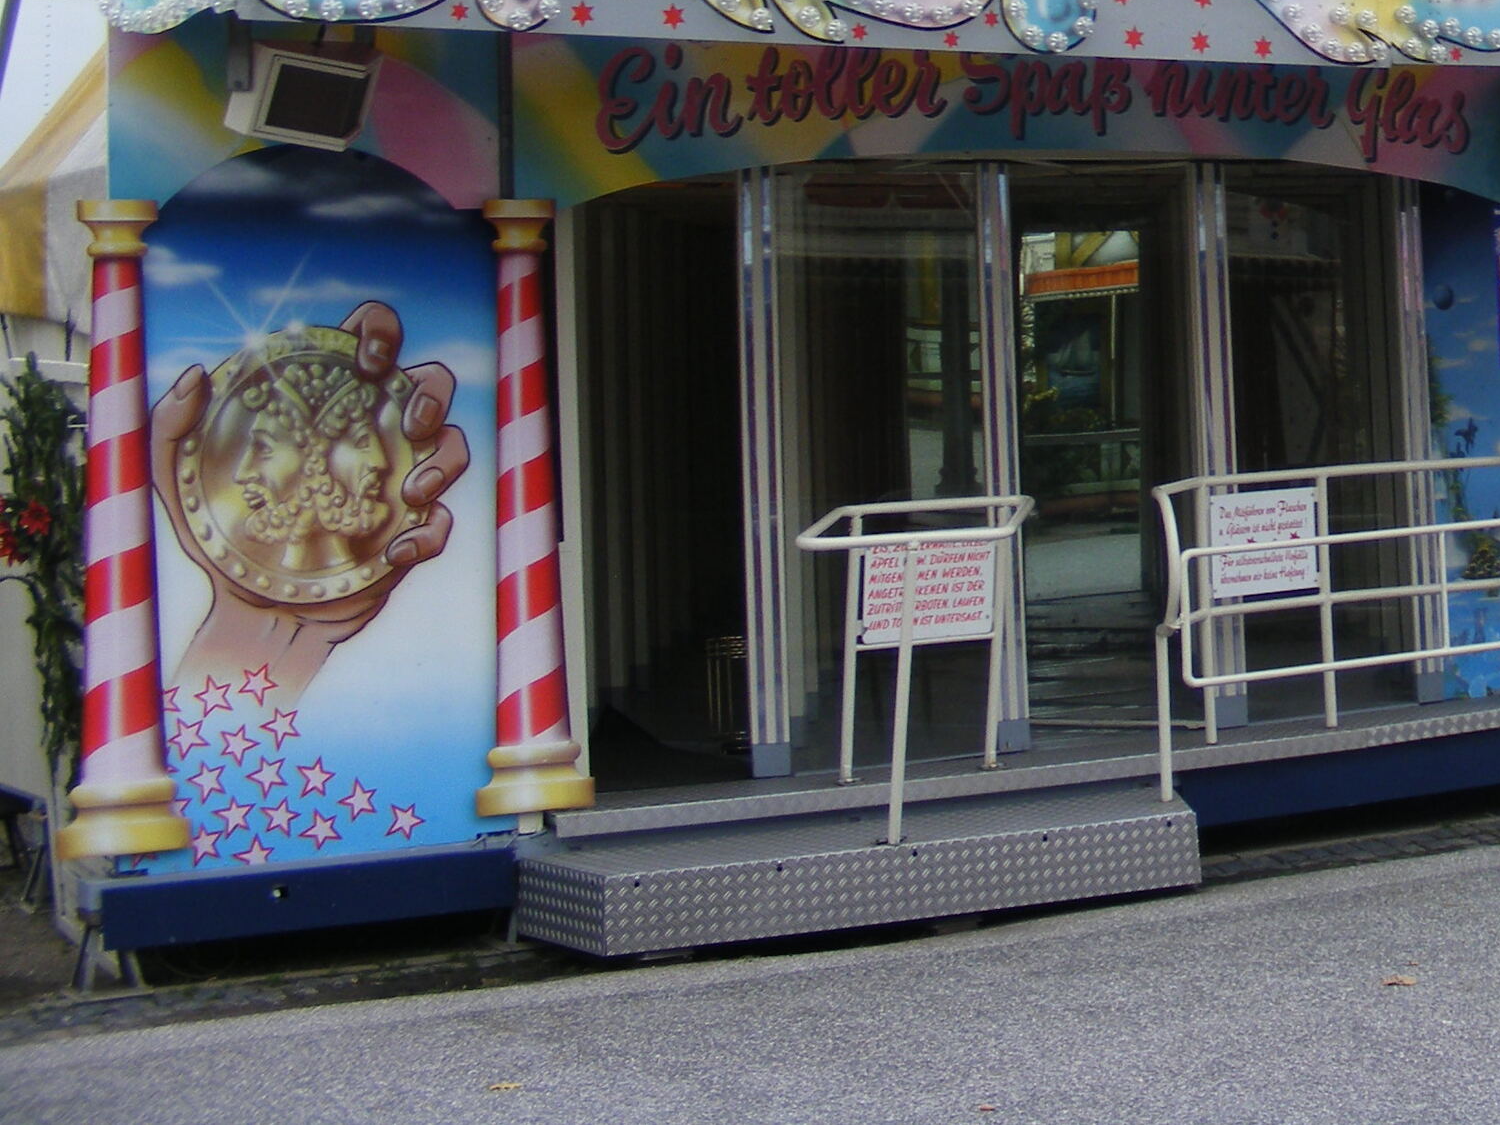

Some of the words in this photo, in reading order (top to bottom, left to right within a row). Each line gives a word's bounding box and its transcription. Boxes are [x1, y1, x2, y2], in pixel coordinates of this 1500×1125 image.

[595, 44, 743, 155] Ein
[745, 46, 947, 126] toller
[961, 52, 1131, 139] Spaß
[1141, 59, 1336, 128] hinter
[1347, 64, 1470, 162] Glas
[868, 569, 938, 585] MITGENMEN
